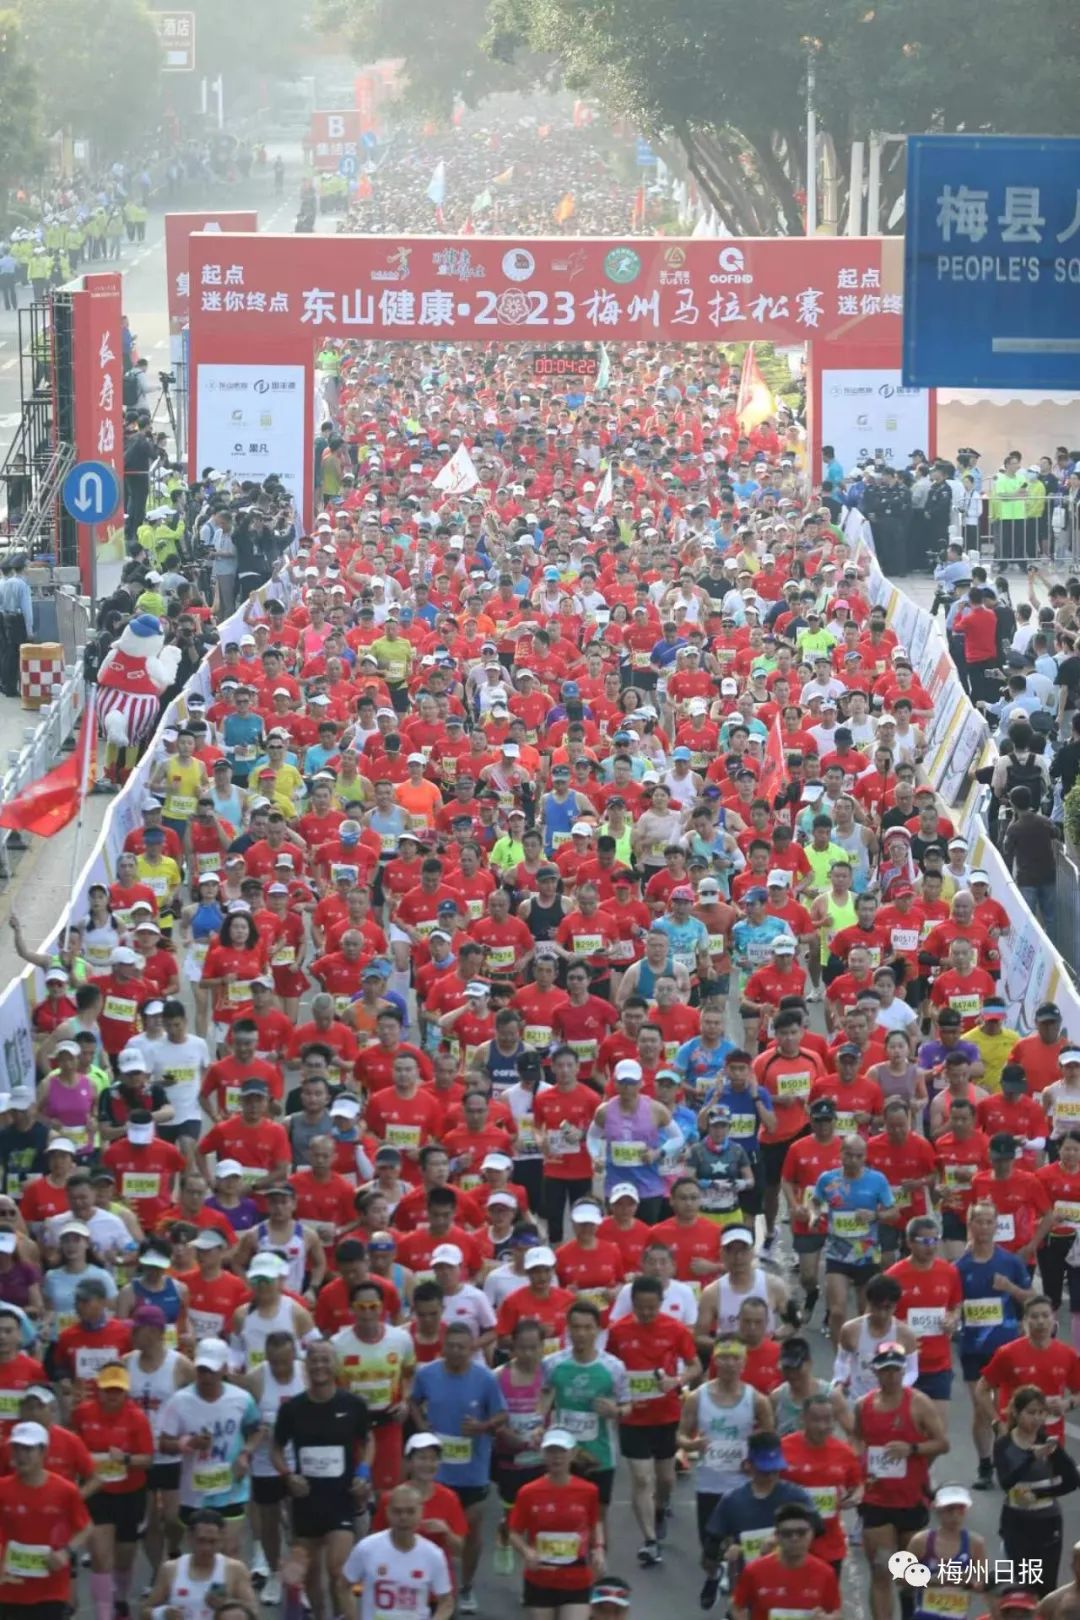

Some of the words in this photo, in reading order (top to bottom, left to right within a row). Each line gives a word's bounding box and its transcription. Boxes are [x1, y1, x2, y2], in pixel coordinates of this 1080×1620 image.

[328, 116, 345, 138] B
[201, 264, 244, 285] 起点
[837, 268, 881, 288] 起点
[937, 255, 1040, 281] PEOPLE'S
[201, 291, 289, 312] 迷你终点
[535, 359, 596, 374] 00:04:22
